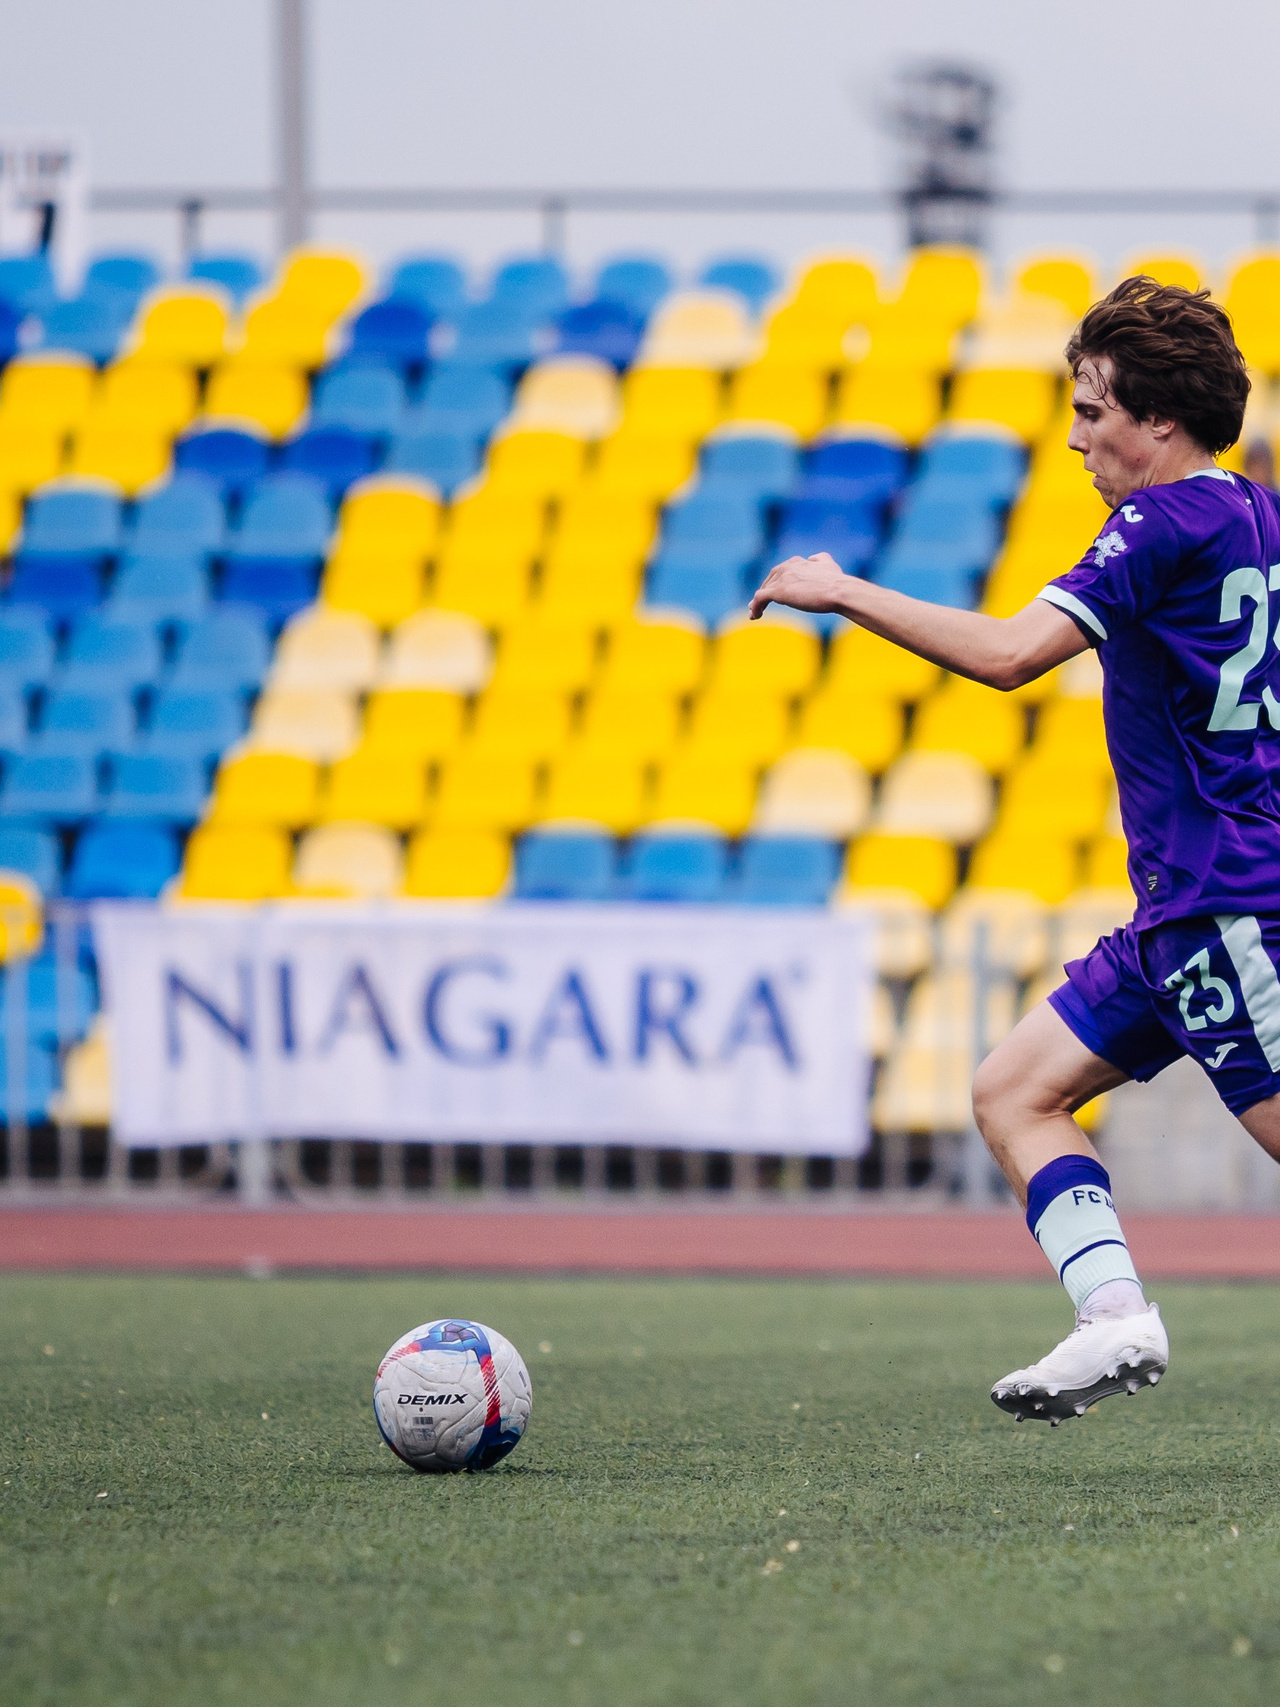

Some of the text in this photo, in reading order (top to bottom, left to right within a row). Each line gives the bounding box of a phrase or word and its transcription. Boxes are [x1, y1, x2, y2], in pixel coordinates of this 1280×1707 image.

[162, 956, 800, 1070] NIAGARA
[1164, 947, 1234, 1031] 23
[1072, 1190, 1101, 1206] FC
[397, 1393, 468, 1406] DEMIX
